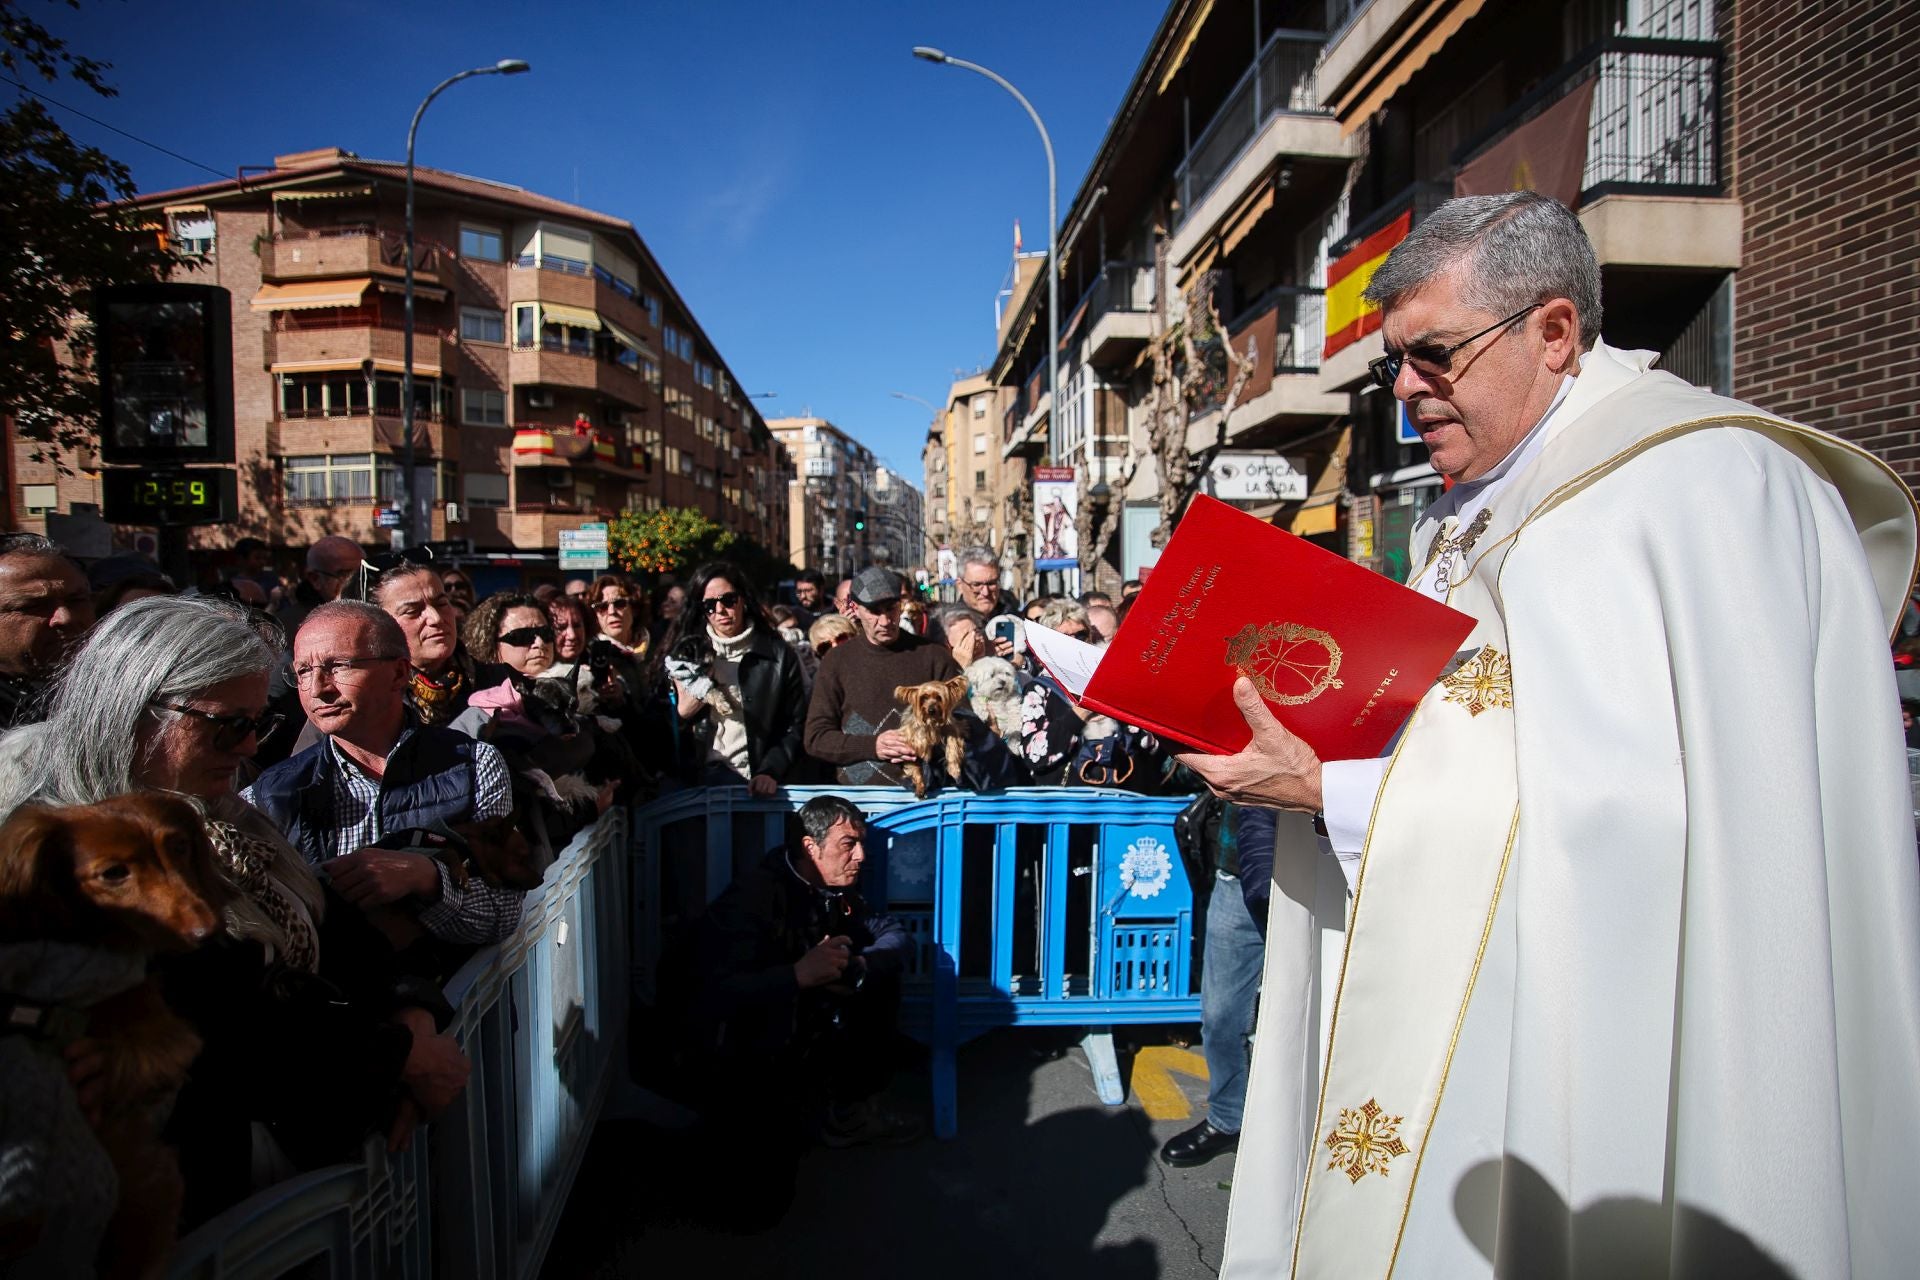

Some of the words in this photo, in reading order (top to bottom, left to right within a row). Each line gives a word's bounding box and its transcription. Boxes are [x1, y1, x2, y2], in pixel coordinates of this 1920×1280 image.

[134, 481, 205, 505] 12:59
[1246, 482, 1261, 493] LA
[1184, 598, 1202, 619] San
[1201, 563, 1222, 596] Antón
